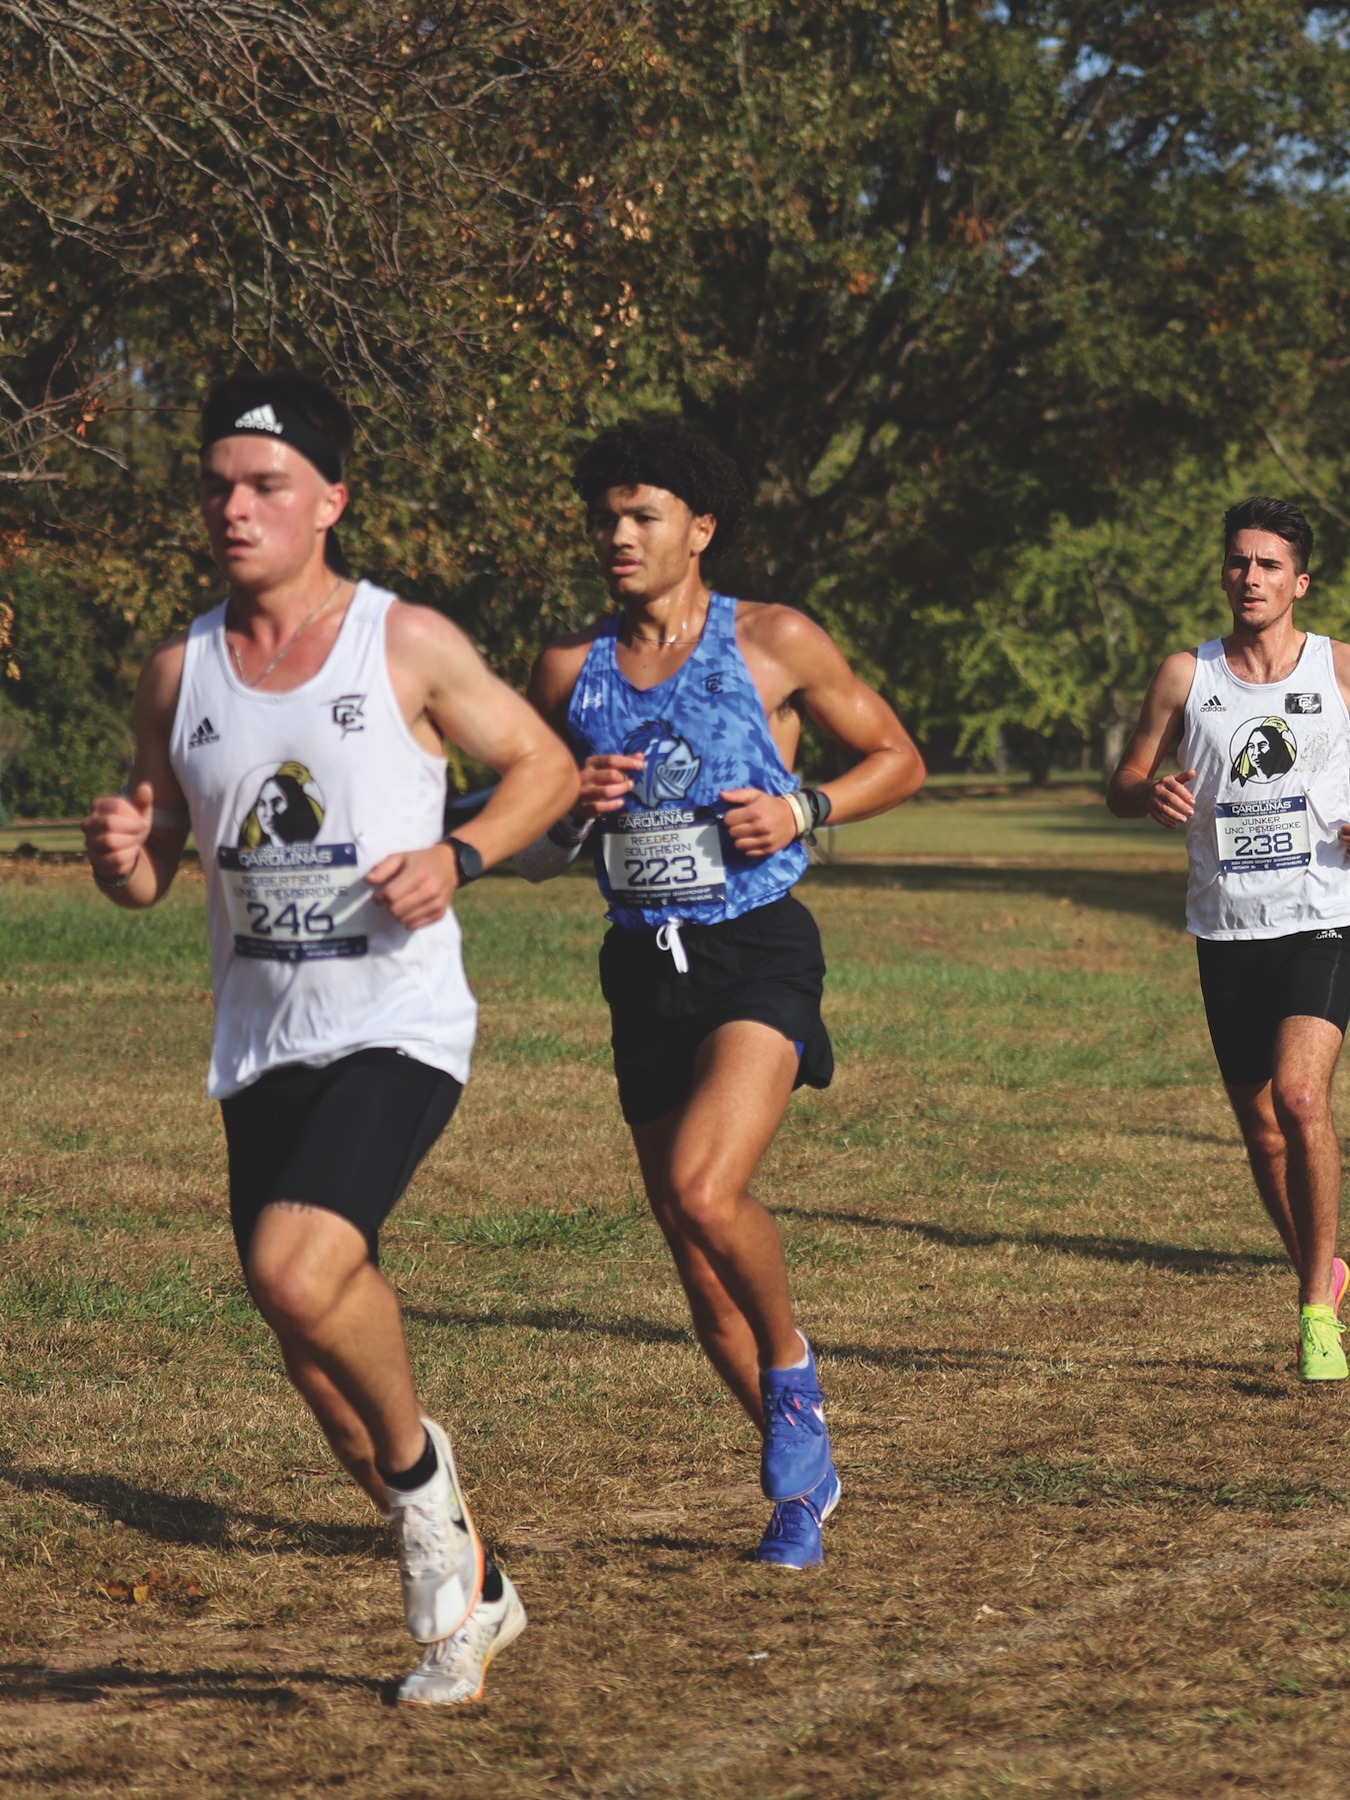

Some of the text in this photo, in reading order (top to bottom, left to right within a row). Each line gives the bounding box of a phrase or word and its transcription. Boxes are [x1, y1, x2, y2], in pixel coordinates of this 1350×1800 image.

[234, 417, 284, 435] adidas
[1200, 705, 1227, 713] adidas
[631, 809, 681, 818] CONFERENCE
[1231, 801, 1292, 815] CAROLINAS
[618, 812, 695, 828] CAROLINAS
[1242, 816, 1280, 826] JUNKER
[1224, 821, 1301, 835] UNC PEMBROKE
[631, 833, 679, 846] REEDER
[1234, 832, 1293, 856] 238
[624, 843, 692, 857] SOUTHERN
[239, 850, 333, 866] CAROLINAS
[624, 855, 697, 887] 223
[241, 874, 329, 887] ROBERTSON
[246, 902, 334, 935] 246
